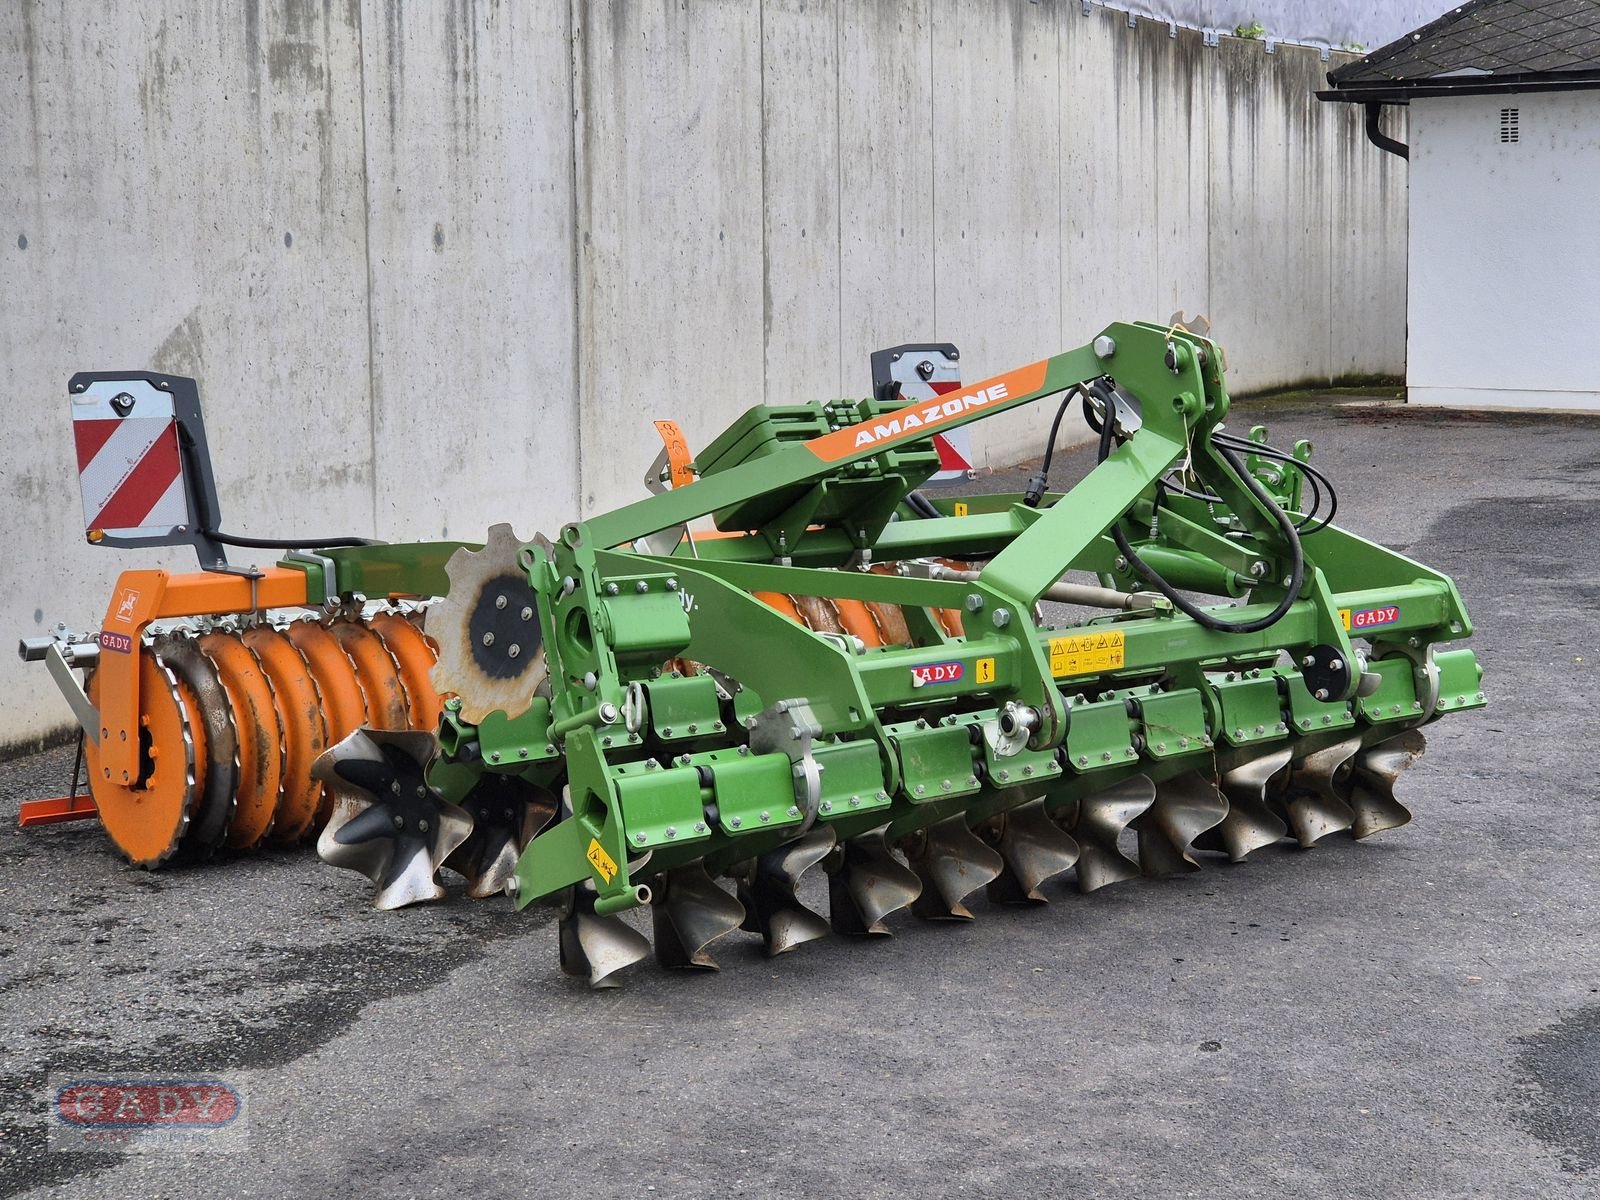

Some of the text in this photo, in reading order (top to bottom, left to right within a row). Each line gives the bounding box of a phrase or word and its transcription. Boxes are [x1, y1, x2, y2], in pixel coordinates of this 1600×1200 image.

[855, 383, 1009, 447] AMAZONE
[677, 587, 699, 612] dy.
[1356, 608, 1397, 626] GADY
[102, 634, 129, 650] GADY
[921, 665, 958, 681] ADY
